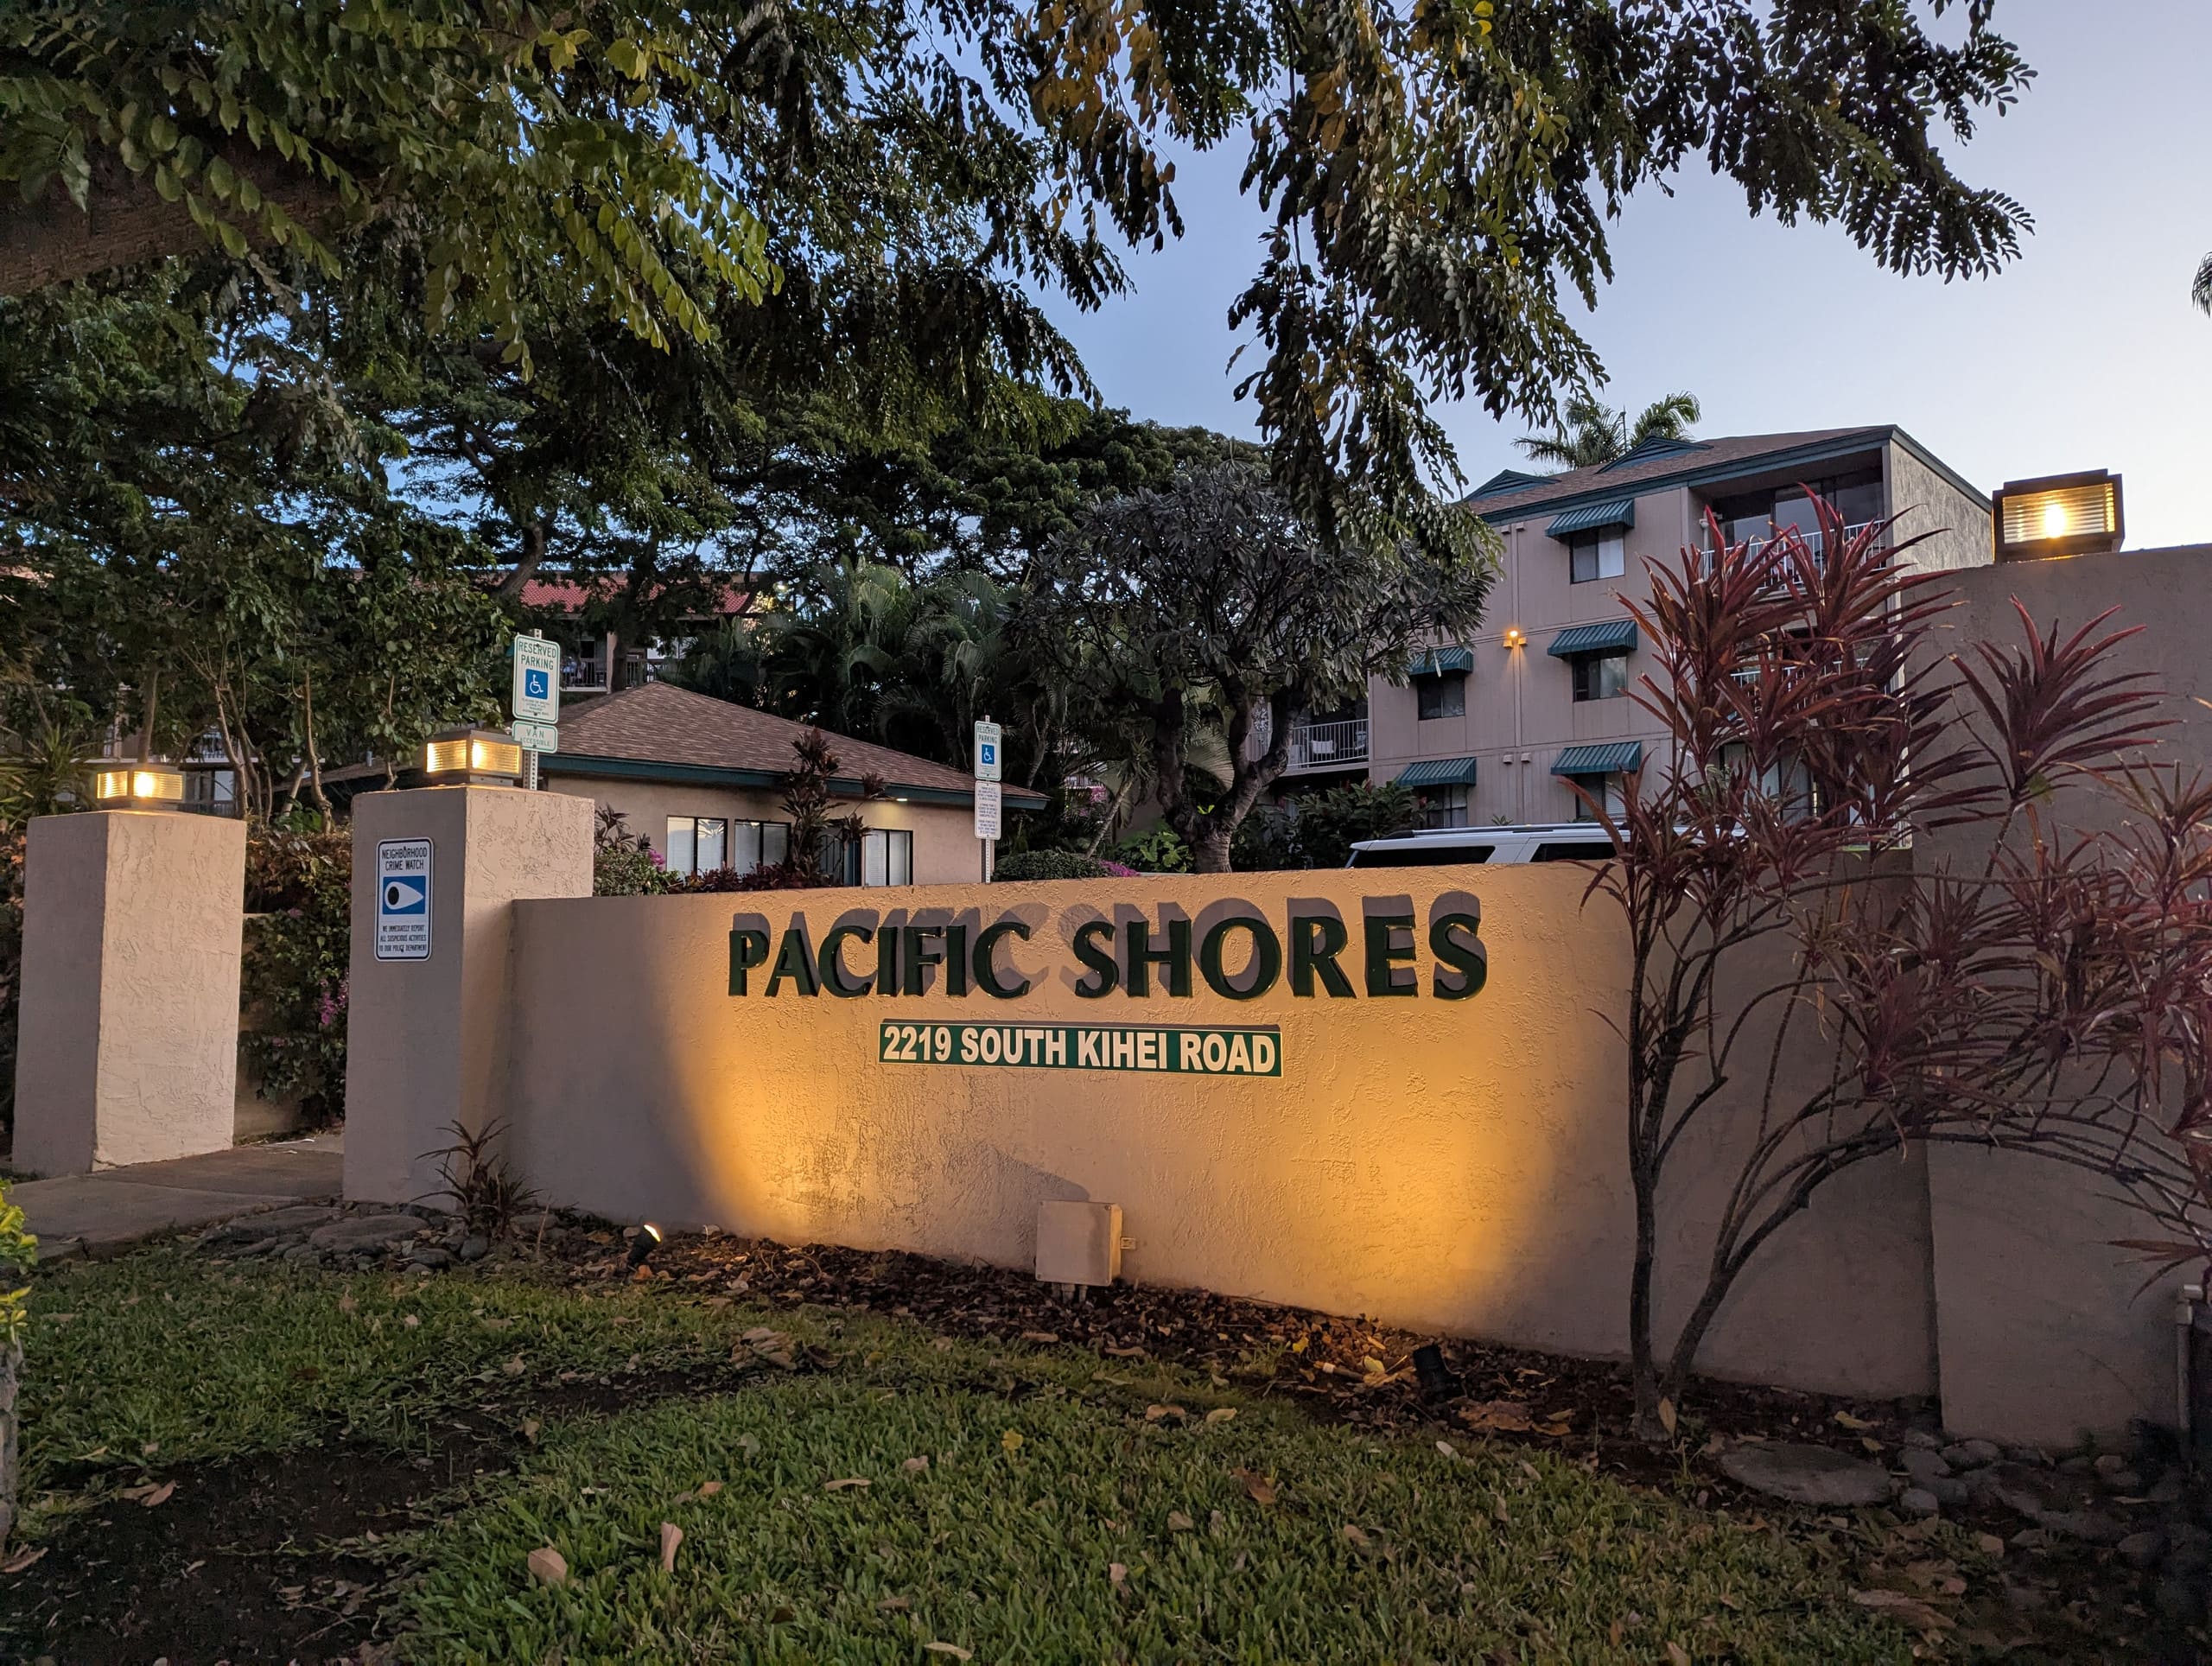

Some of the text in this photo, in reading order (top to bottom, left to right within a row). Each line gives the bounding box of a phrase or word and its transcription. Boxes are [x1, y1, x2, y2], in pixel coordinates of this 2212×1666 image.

[518, 641, 556, 658] RESERVED
[521, 654, 554, 671] PARKING
[526, 728, 544, 739] VAN
[978, 734, 997, 744] PARKING
[382, 847, 428, 860] NEIGHBORHOOD
[385, 859, 424, 871] CRIME WATCH
[728, 913, 1487, 1000] PACIFIC SHORES
[883, 1026, 1274, 1073] 2219 SOUTH KIHEI ROAD
